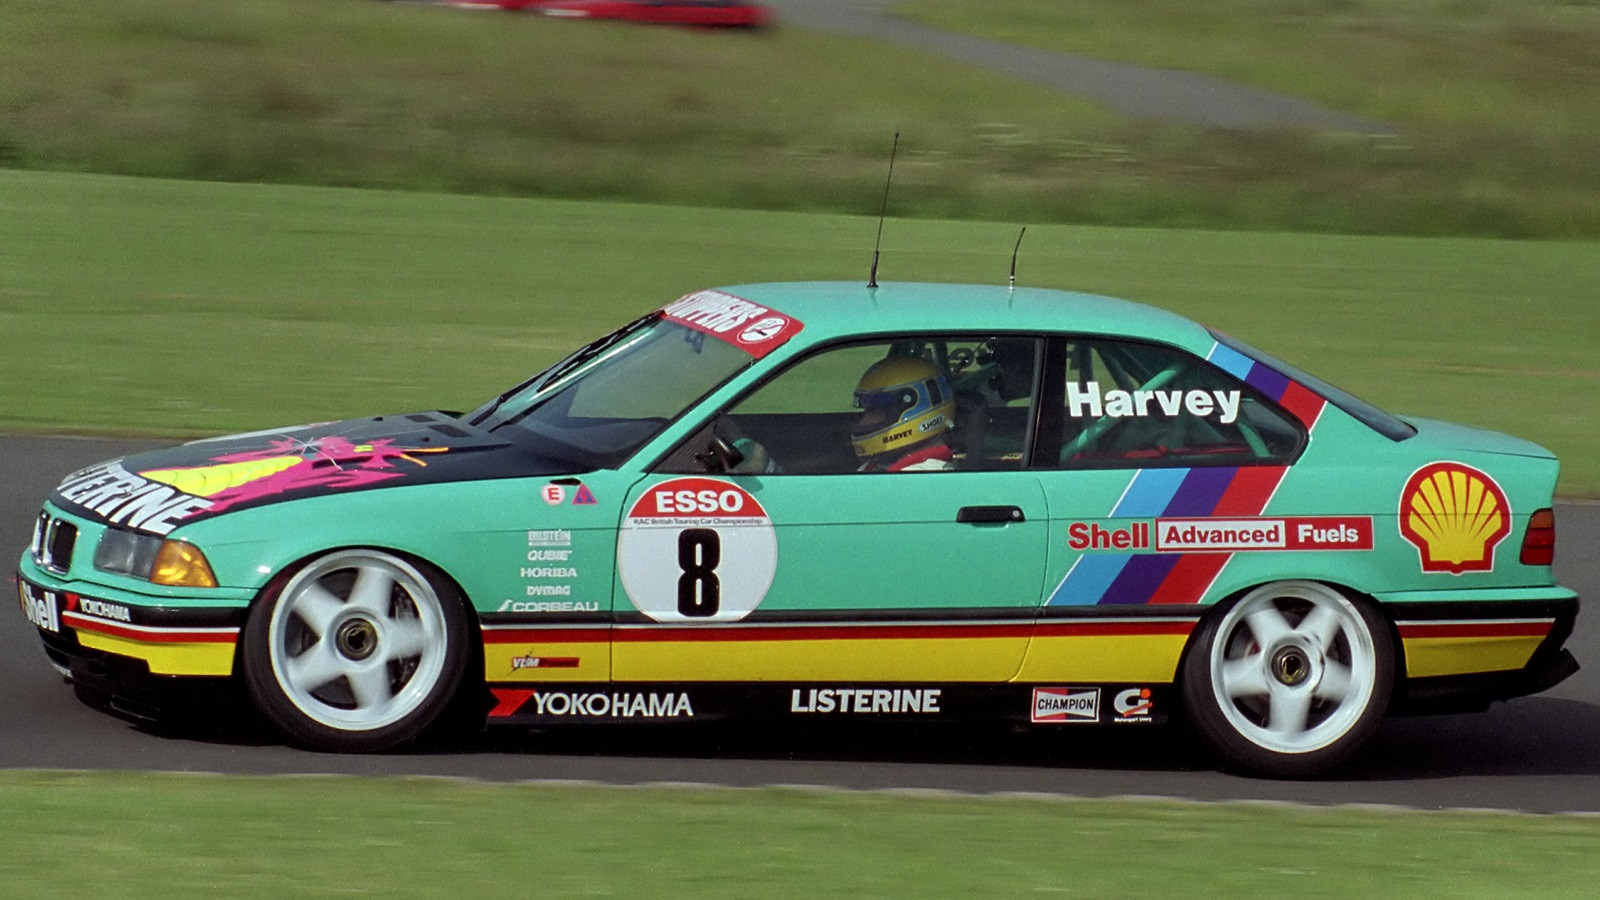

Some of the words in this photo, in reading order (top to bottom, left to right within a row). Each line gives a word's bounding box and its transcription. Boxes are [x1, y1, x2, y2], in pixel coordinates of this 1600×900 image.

[1067, 382, 1241, 423] Harvey
[882, 429, 913, 443] HARVEY
[548, 487, 560, 500] E
[656, 490, 744, 513] ESSO
[674, 518, 699, 527] Touring
[713, 518, 764, 526] Championship
[528, 530, 571, 541] BILSTEIN
[1068, 523, 1149, 549] Shell
[1165, 525, 1280, 545] Advanced
[1298, 524, 1360, 544] Fuels
[520, 567, 578, 577] HORIBA
[678, 528, 720, 617] 8
[526, 585, 571, 596] DYMAG
[80, 598, 131, 622] YOKOHAMA
[512, 601, 599, 612] CORBEAU
[533, 692, 694, 717] YOKOHAMA
[791, 689, 941, 713] LISTERINE
[1037, 699, 1094, 711] CHAMPION
